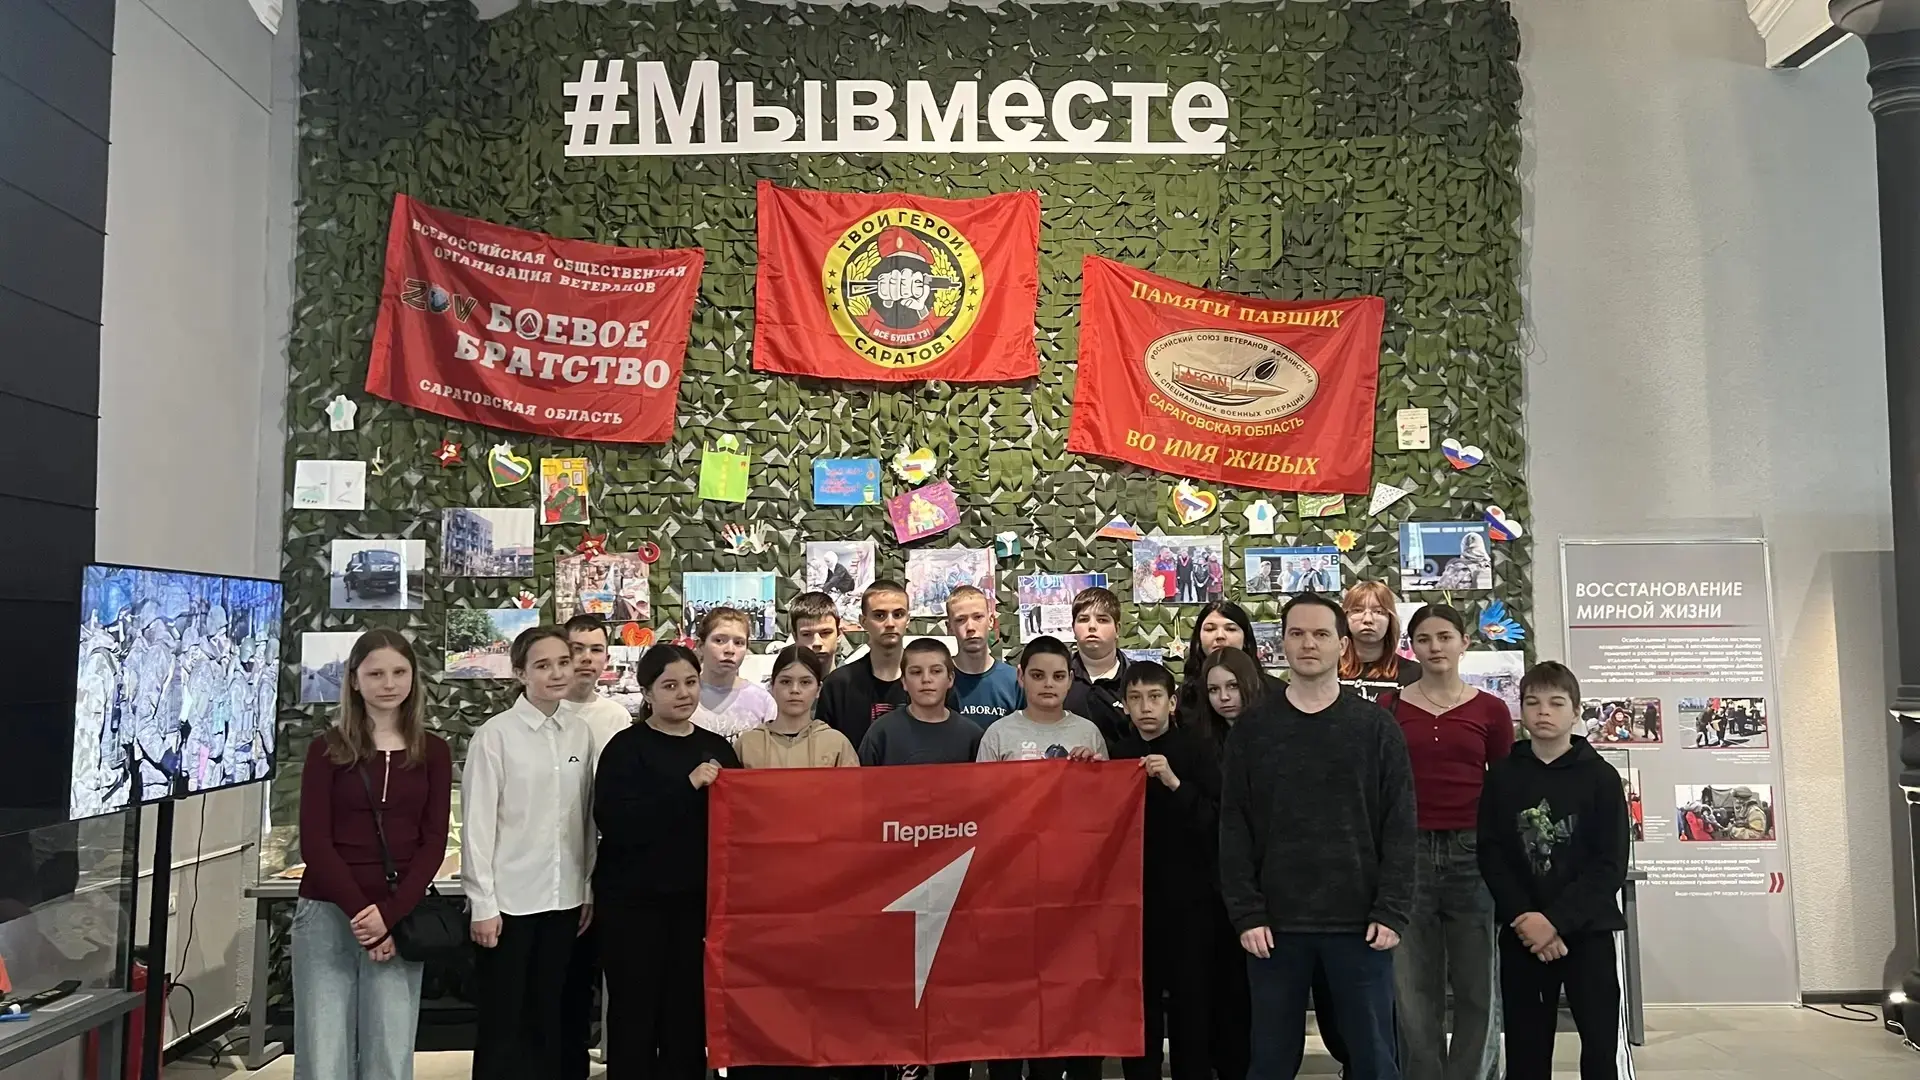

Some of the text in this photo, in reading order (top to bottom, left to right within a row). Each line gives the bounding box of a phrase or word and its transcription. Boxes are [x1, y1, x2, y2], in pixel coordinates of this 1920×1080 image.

[564, 59, 1229, 148] #Мывместе
[412, 219, 687, 280] ВСЕРОССИЙСКАЯ ОБЩЕСТВЕННАЯ
[839, 214, 890, 252] ТВОИ
[434, 246, 656, 293] ОРГАНИЗАЦИЯ ВЕТЕРАНОВ
[486, 302, 649, 348] БОЕВОЕ
[1130, 280, 1344, 328] ПАМЯТИ ПАВШИХ
[454, 330, 671, 389] БРАТСТВО
[890, 332, 916, 344] БУДЕТ
[1150, 334, 1313, 384] РОССИЙСКИЙ СОЮЗ ВЕТЕРАНОВ АФГАНИСТАНА
[419, 379, 623, 425] САРАТОВСКАЯ ОБЛАСТЬ
[1148, 393, 1304, 437] САРАТОВСКАЯ ОБЛАСТЬ
[1160, 378, 1217, 413] СПЕЦИАЛЬНЫХ
[1220, 408, 1261, 417] ВОЕННЫХ
[1265, 393, 1306, 415] ОПЕРАЦИЙ
[1125, 429, 1320, 476] ВО ИМЯ ЖИВЫХ
[1575, 582, 1743, 598] ВОССТАНОВЛЕНИЕ
[1576, 601, 1722, 619] МИРНОЙ ЖИЗНИ
[883, 820, 978, 847] Первые
